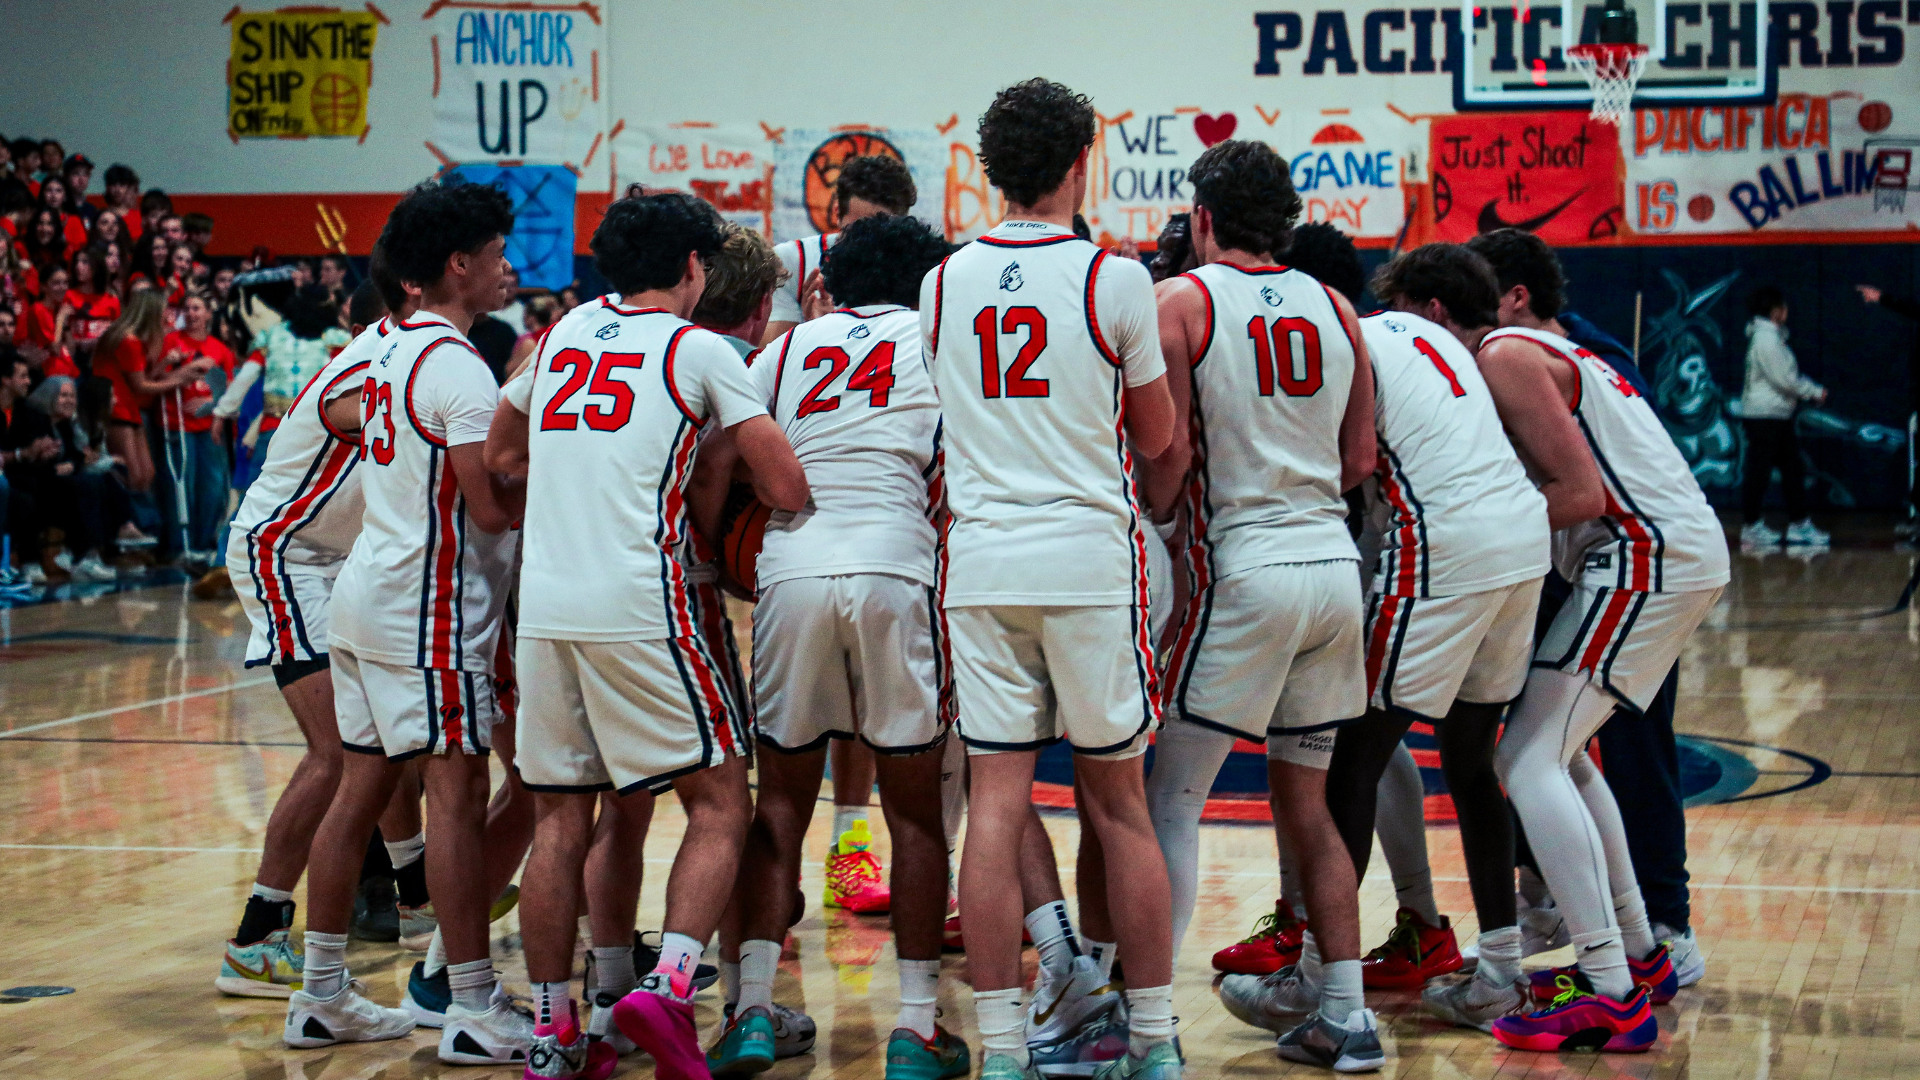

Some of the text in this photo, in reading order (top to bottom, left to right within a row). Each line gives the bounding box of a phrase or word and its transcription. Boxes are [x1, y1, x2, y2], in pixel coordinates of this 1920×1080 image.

[239, 20, 372, 63] SINK THE
[455, 11, 573, 67] ANCHOR
[234, 71, 304, 105] SHIP
[477, 79, 549, 155] UP
[1118, 114, 1178, 155] WE
[1633, 97, 1831, 159] PACIFICA
[701, 142, 755, 170] Love
[1290, 151, 1394, 192] GAME
[1441, 125, 1592, 169] Just Shoot
[1112, 167, 1187, 201] OUR
[1637, 180, 1678, 231] IS
[1026, 222, 1048, 230] PRO
[1308, 196, 1369, 231] DAY
[973, 305, 1050, 399] 12
[1247, 315, 1323, 397] 10
[1413, 336, 1466, 398] 1
[540, 346, 645, 432] 25
[796, 340, 896, 420] 24
[360, 376, 396, 466] 23
